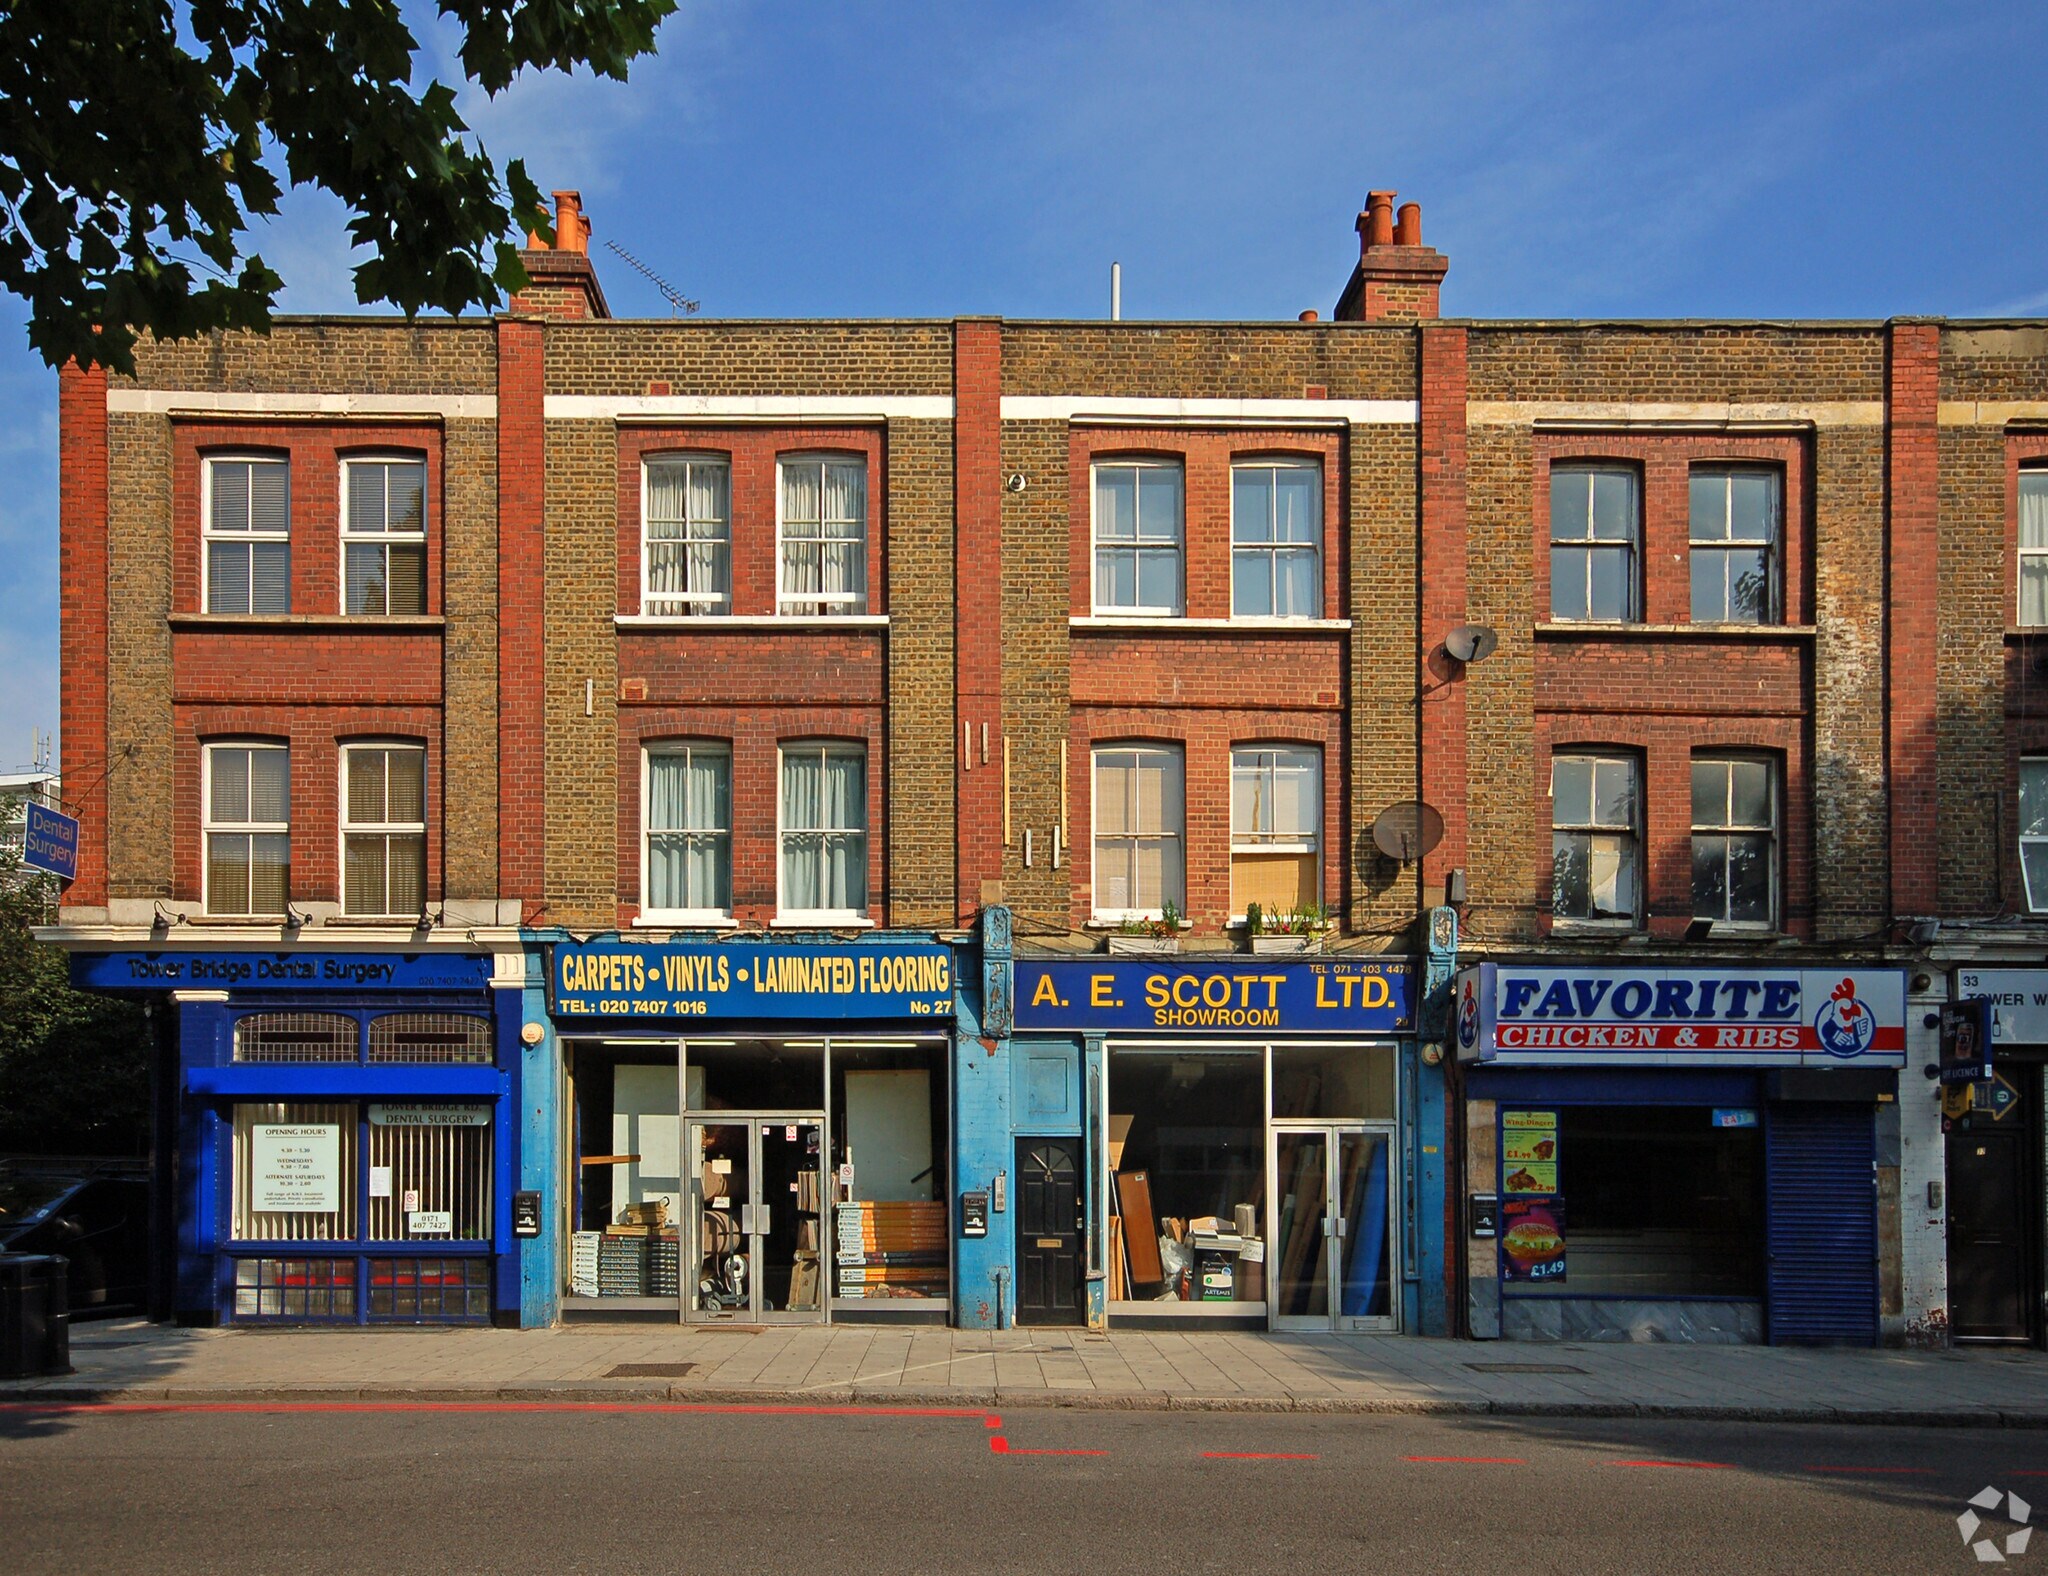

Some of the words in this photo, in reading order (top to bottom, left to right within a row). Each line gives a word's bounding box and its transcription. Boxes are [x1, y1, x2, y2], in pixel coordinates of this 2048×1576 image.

[33, 811, 73, 842] Dental
[27, 832, 75, 868] Surgery
[127, 959, 185, 978] Tower
[191, 959, 251, 982] Bridge
[257, 959, 318, 979] Dental
[323, 959, 396, 983] Surgery
[562, 954, 645, 992] CARPETS
[662, 955, 730, 992] VINYLS
[753, 956, 855, 993] LAMINATED
[859, 955, 949, 993] FLOORING
[1309, 965, 1330, 974] TEL.
[1333, 965, 1351, 974] 071
[1360, 965, 1381, 974] 403
[1386, 965, 1412, 974] 4478
[418, 977, 435, 986] 020
[437, 977, 457, 986] 7407
[1963, 975, 1979, 987] 33
[1031, 974, 1069, 1007] A.
[1090, 974, 1124, 1007] E.
[1145, 974, 1287, 1008] SCOTT
[1316, 975, 1396, 1008] LTD.
[1500, 979, 1801, 1019] FAVORITE
[559, 1000, 596, 1013] TEL:
[599, 1000, 630, 1014] 020
[632, 1000, 668, 1014] 7407
[672, 1001, 707, 1015] 1016
[910, 1000, 931, 1014] No
[933, 1000, 952, 1014] 27
[1154, 1009, 1279, 1026] SHOWROOM
[1501, 1027, 1661, 1047] CHICKEN
[1673, 1027, 1699, 1047] &
[1714, 1027, 1800, 1048] RIBS
[1952, 1066, 1979, 1079] LICENCE
[386, 1114, 424, 1124] DENTAL
[428, 1114, 475, 1124] SURGERY
[1530, 1260, 1565, 1278] £1.49
[1204, 1288, 1230, 1296] ARTEMIS
